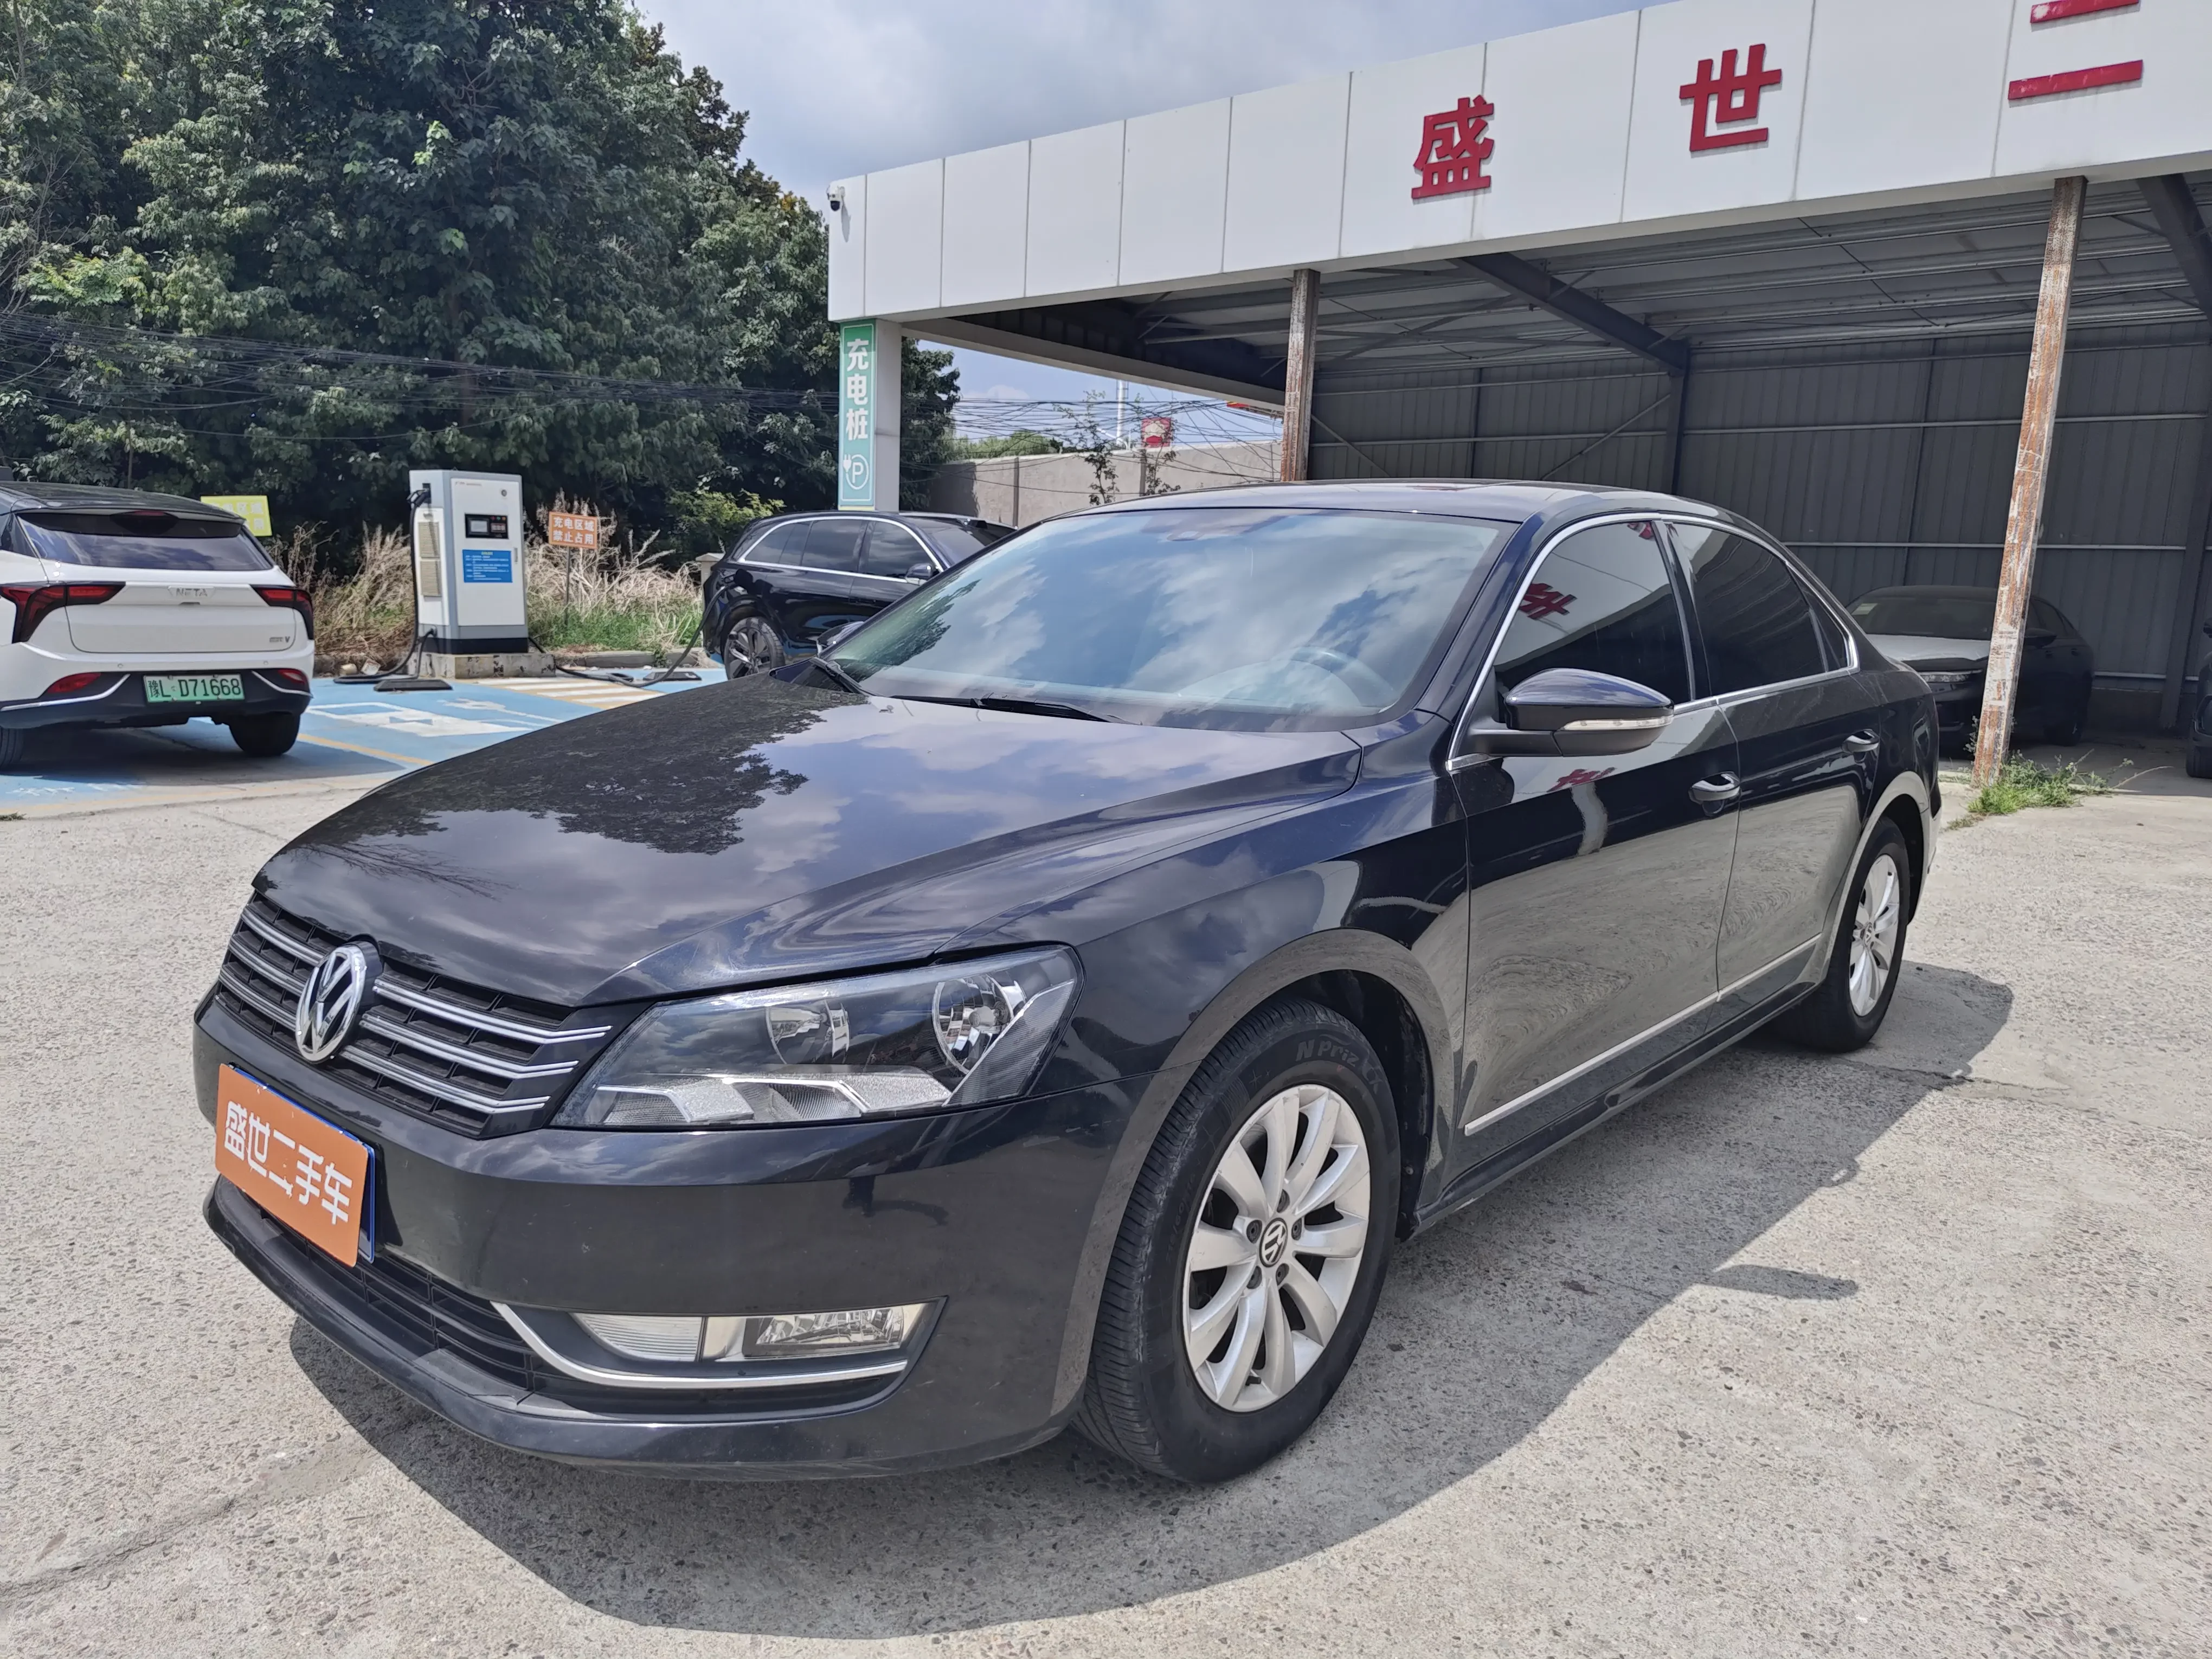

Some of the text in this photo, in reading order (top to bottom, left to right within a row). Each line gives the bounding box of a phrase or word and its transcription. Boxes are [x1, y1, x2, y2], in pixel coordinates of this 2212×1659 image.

[846, 338, 869, 441] 充电桩
[554, 517, 594, 532] 充电区域
[553, 530, 594, 545] 禁止占用
[176, 588, 208, 596] NETA
[224, 1101, 352, 1225] 盛世二手车
